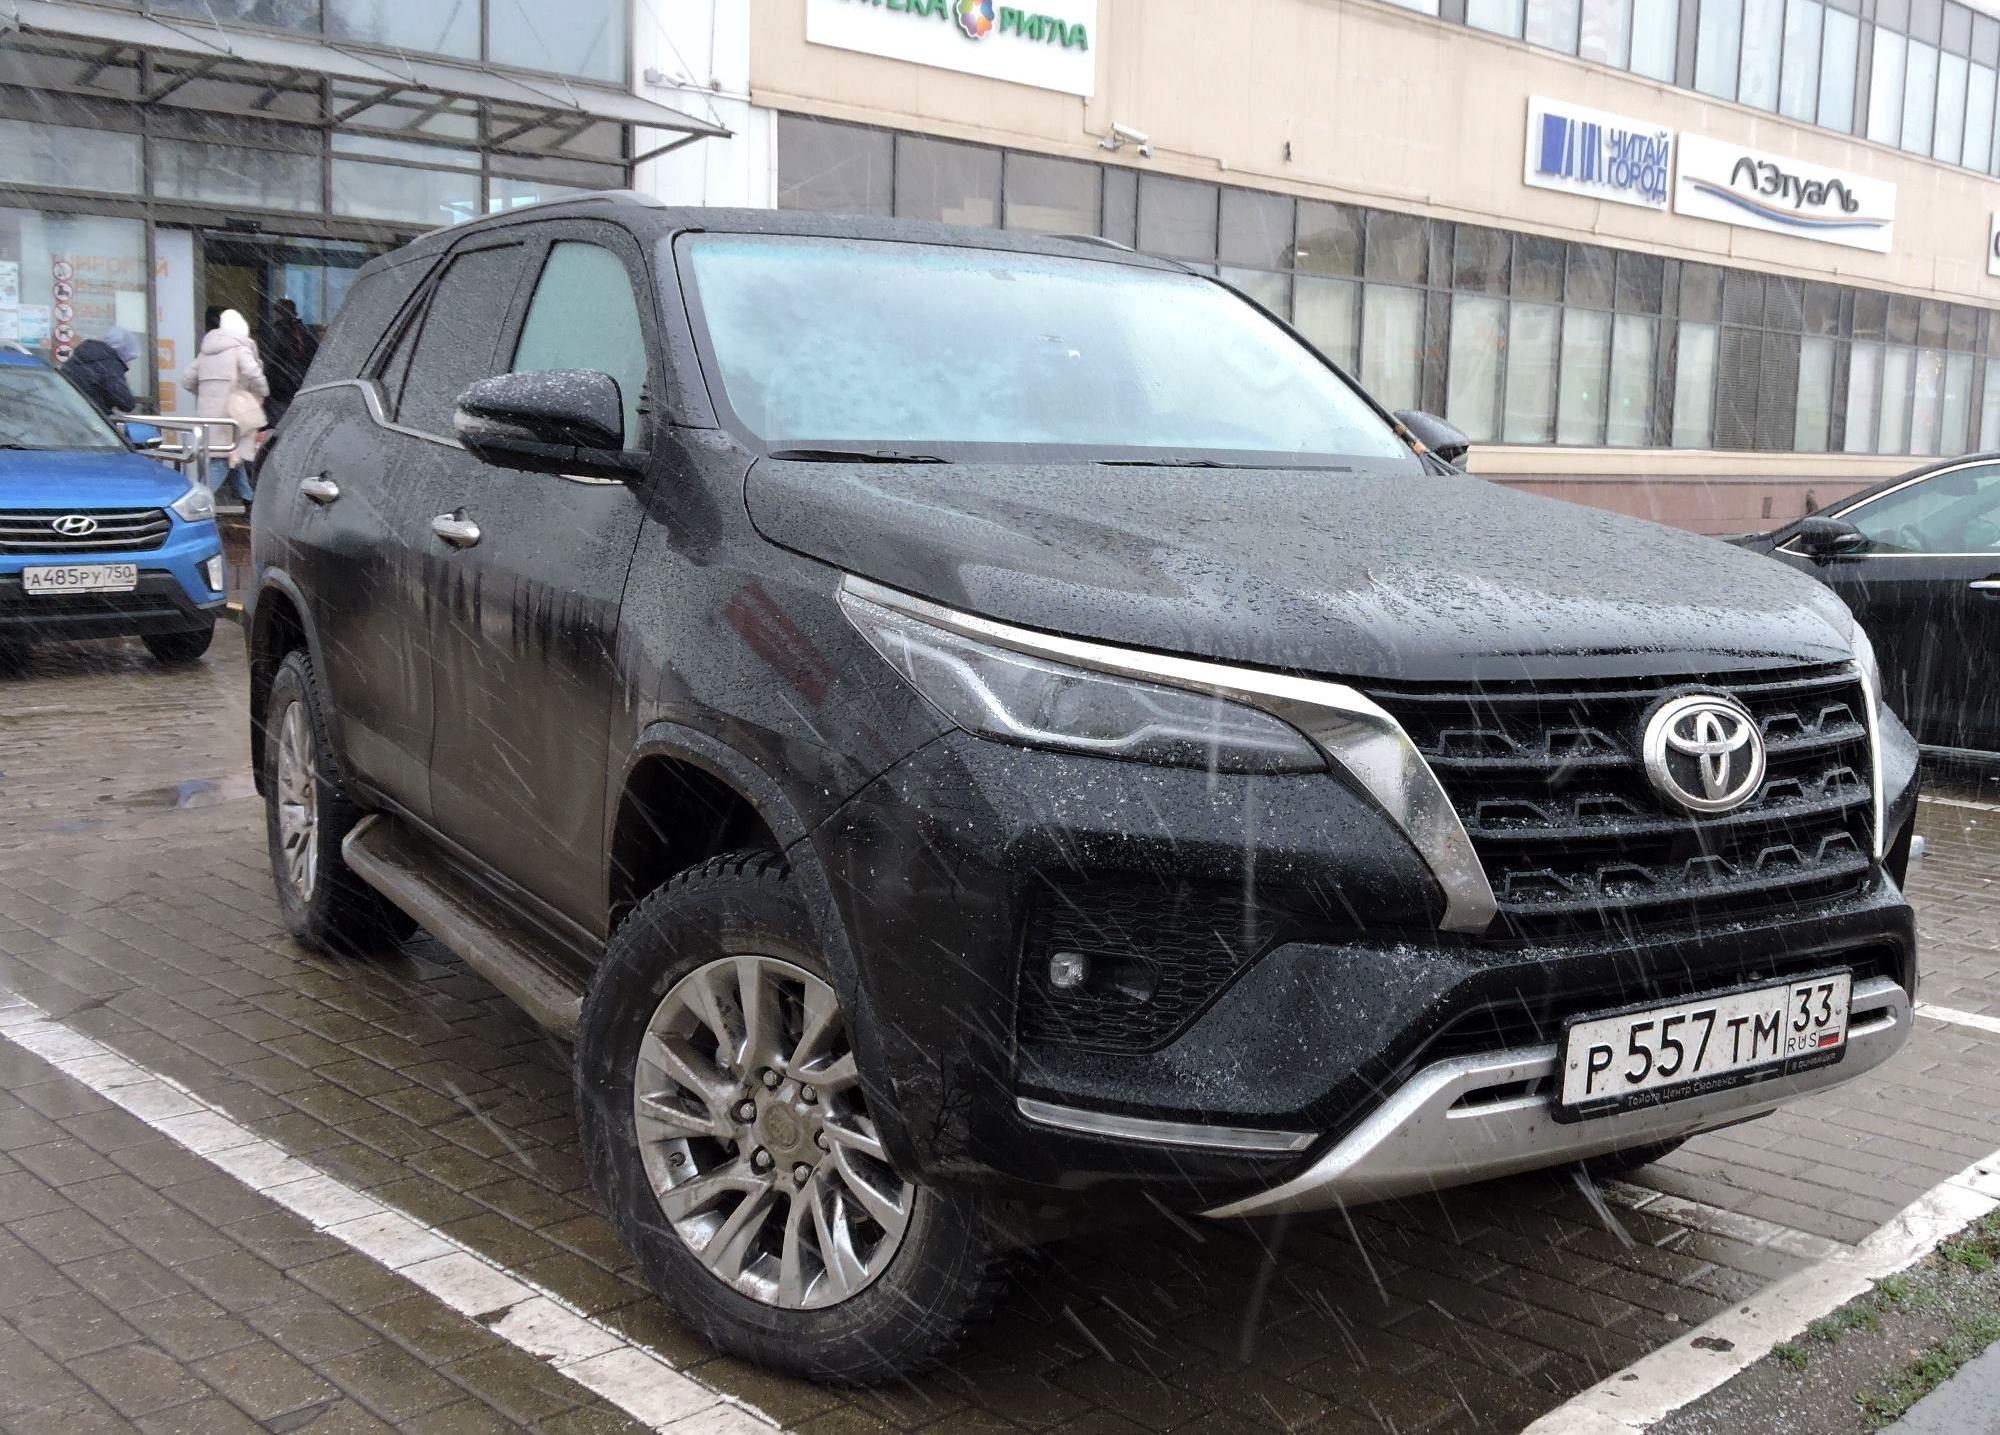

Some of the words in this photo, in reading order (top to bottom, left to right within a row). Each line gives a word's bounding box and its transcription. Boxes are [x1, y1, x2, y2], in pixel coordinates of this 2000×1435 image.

[1000, 6, 1088, 50] РИГЛА
[1611, 128, 1669, 167] ЧИТАЙ
[1607, 157, 1667, 202] ГОРОД
[104, 566, 131, 579] 750
[1793, 983, 1834, 1031] 33
[1787, 1033, 1817, 1053] RUS
[1663, 1085, 1692, 1100] Центр
[1693, 1076, 1737, 1092] Смоленск
